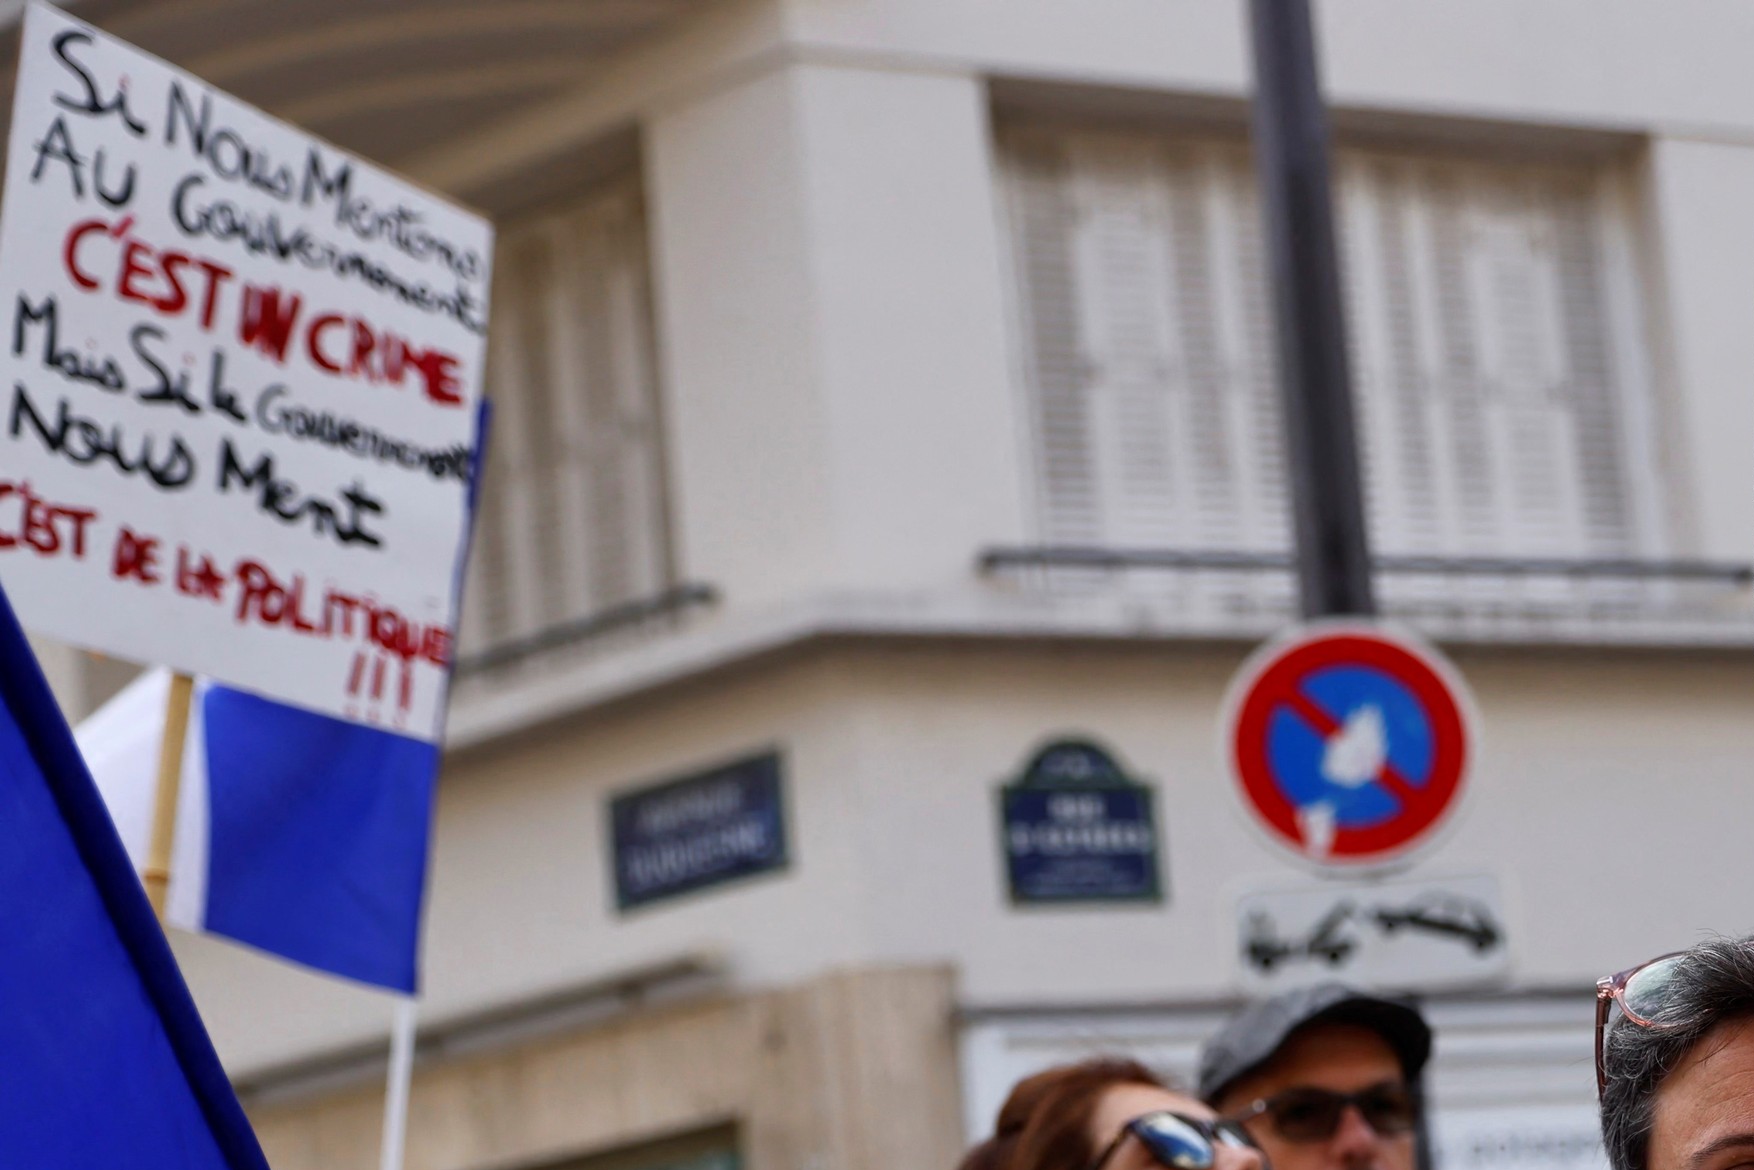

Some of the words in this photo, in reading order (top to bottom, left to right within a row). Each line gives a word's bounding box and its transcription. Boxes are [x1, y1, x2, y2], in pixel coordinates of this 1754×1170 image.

[30, 116, 137, 206] AU
[51, 30, 147, 136] Si
[165, 80, 294, 201] Nous
[64, 216, 234, 332] C'EST
[307, 313, 464, 408] CRIME
[8, 384, 195, 491] Nous
[217, 436, 384, 549] Ment
[112, 526, 162, 585] DE
